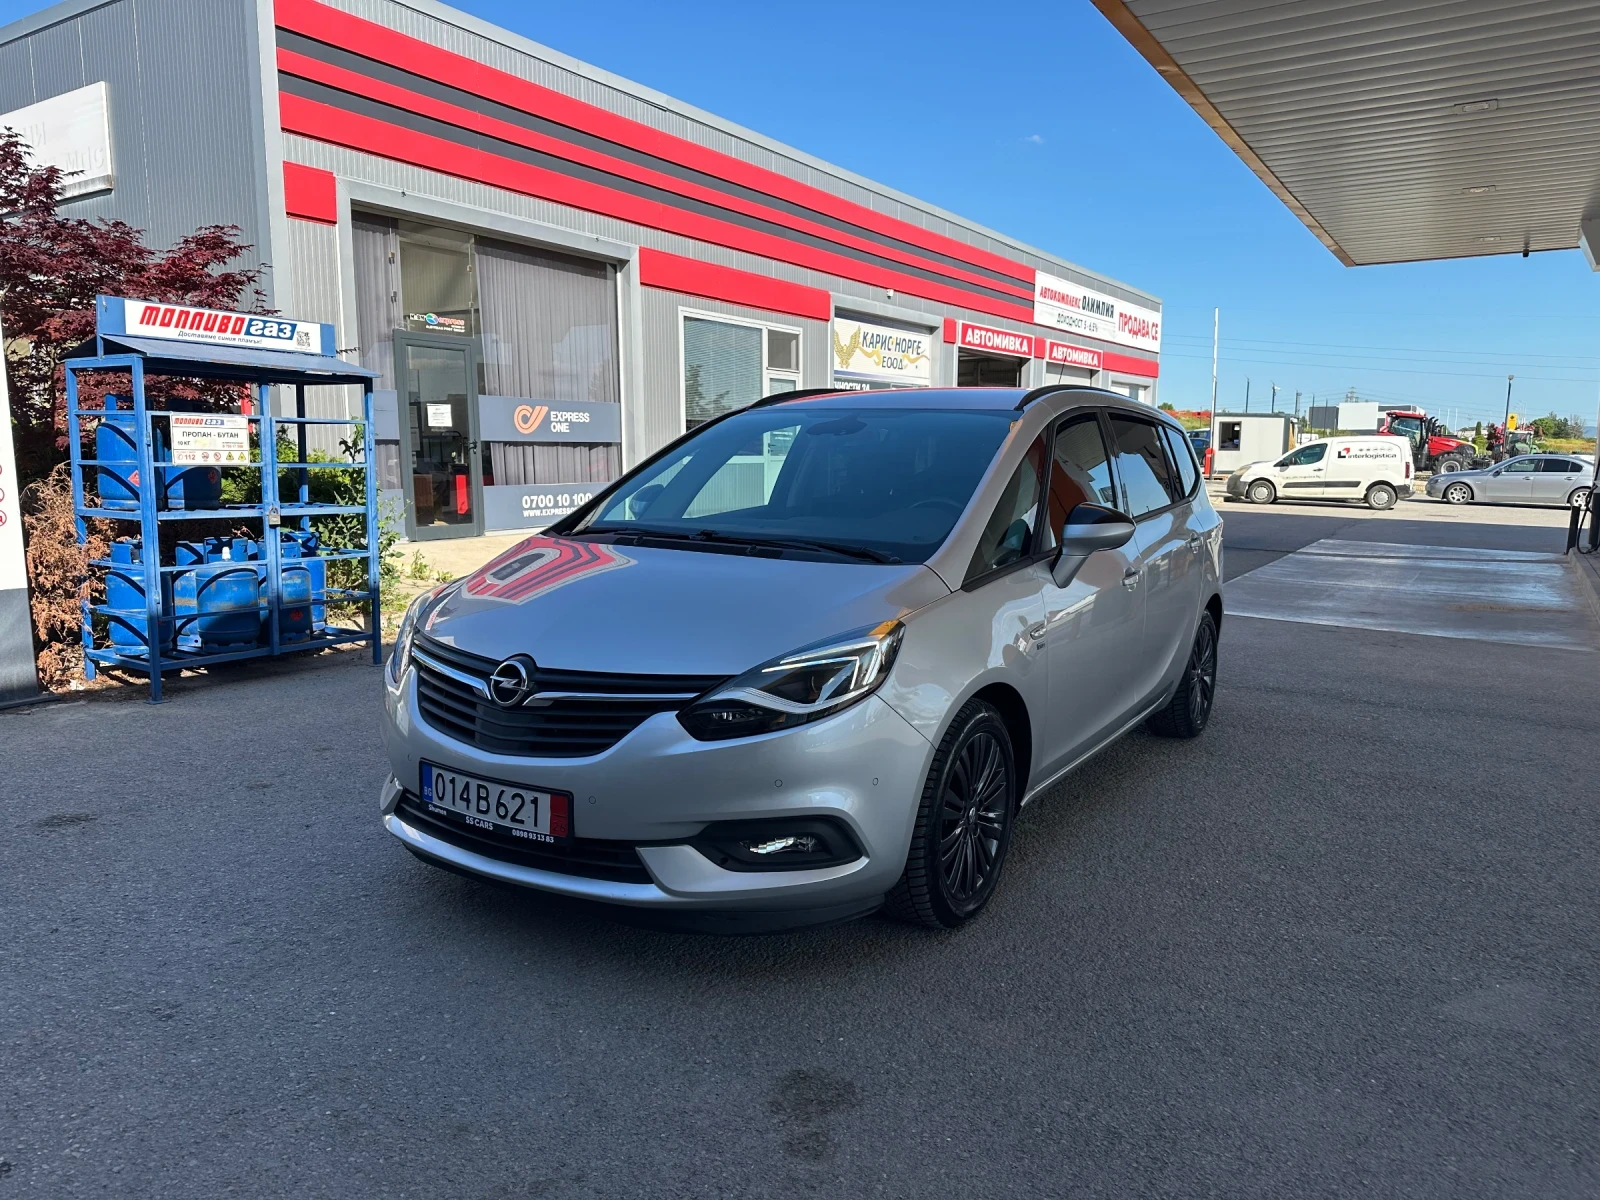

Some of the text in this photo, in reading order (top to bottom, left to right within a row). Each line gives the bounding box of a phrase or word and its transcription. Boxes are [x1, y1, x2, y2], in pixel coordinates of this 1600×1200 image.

[1040, 286, 1114, 318] АВТОКОМПЛЕКС ОЛИМПИЯ
[1118, 312, 1159, 341] ПРОДАВА СЕ
[965, 328, 1028, 353] АВТОМИВКА
[881, 356, 904, 370] ЕООД
[1051, 345, 1099, 366] АВТОМИВКА
[550, 411, 590, 422] EXPRESS
[550, 422, 570, 432] ONE
[522, 495, 554, 508] 0700
[556, 493, 570, 506] 10
[522, 507, 578, 517] WWW.EXPRESSO
[424, 786, 432, 797] BG
[435, 772, 538, 828] 014B621
[465, 816, 494, 831] SS CARS
[512, 829, 528, 839] 0898
[528, 831, 537, 841] 93
[537, 833, 545, 842] 13
